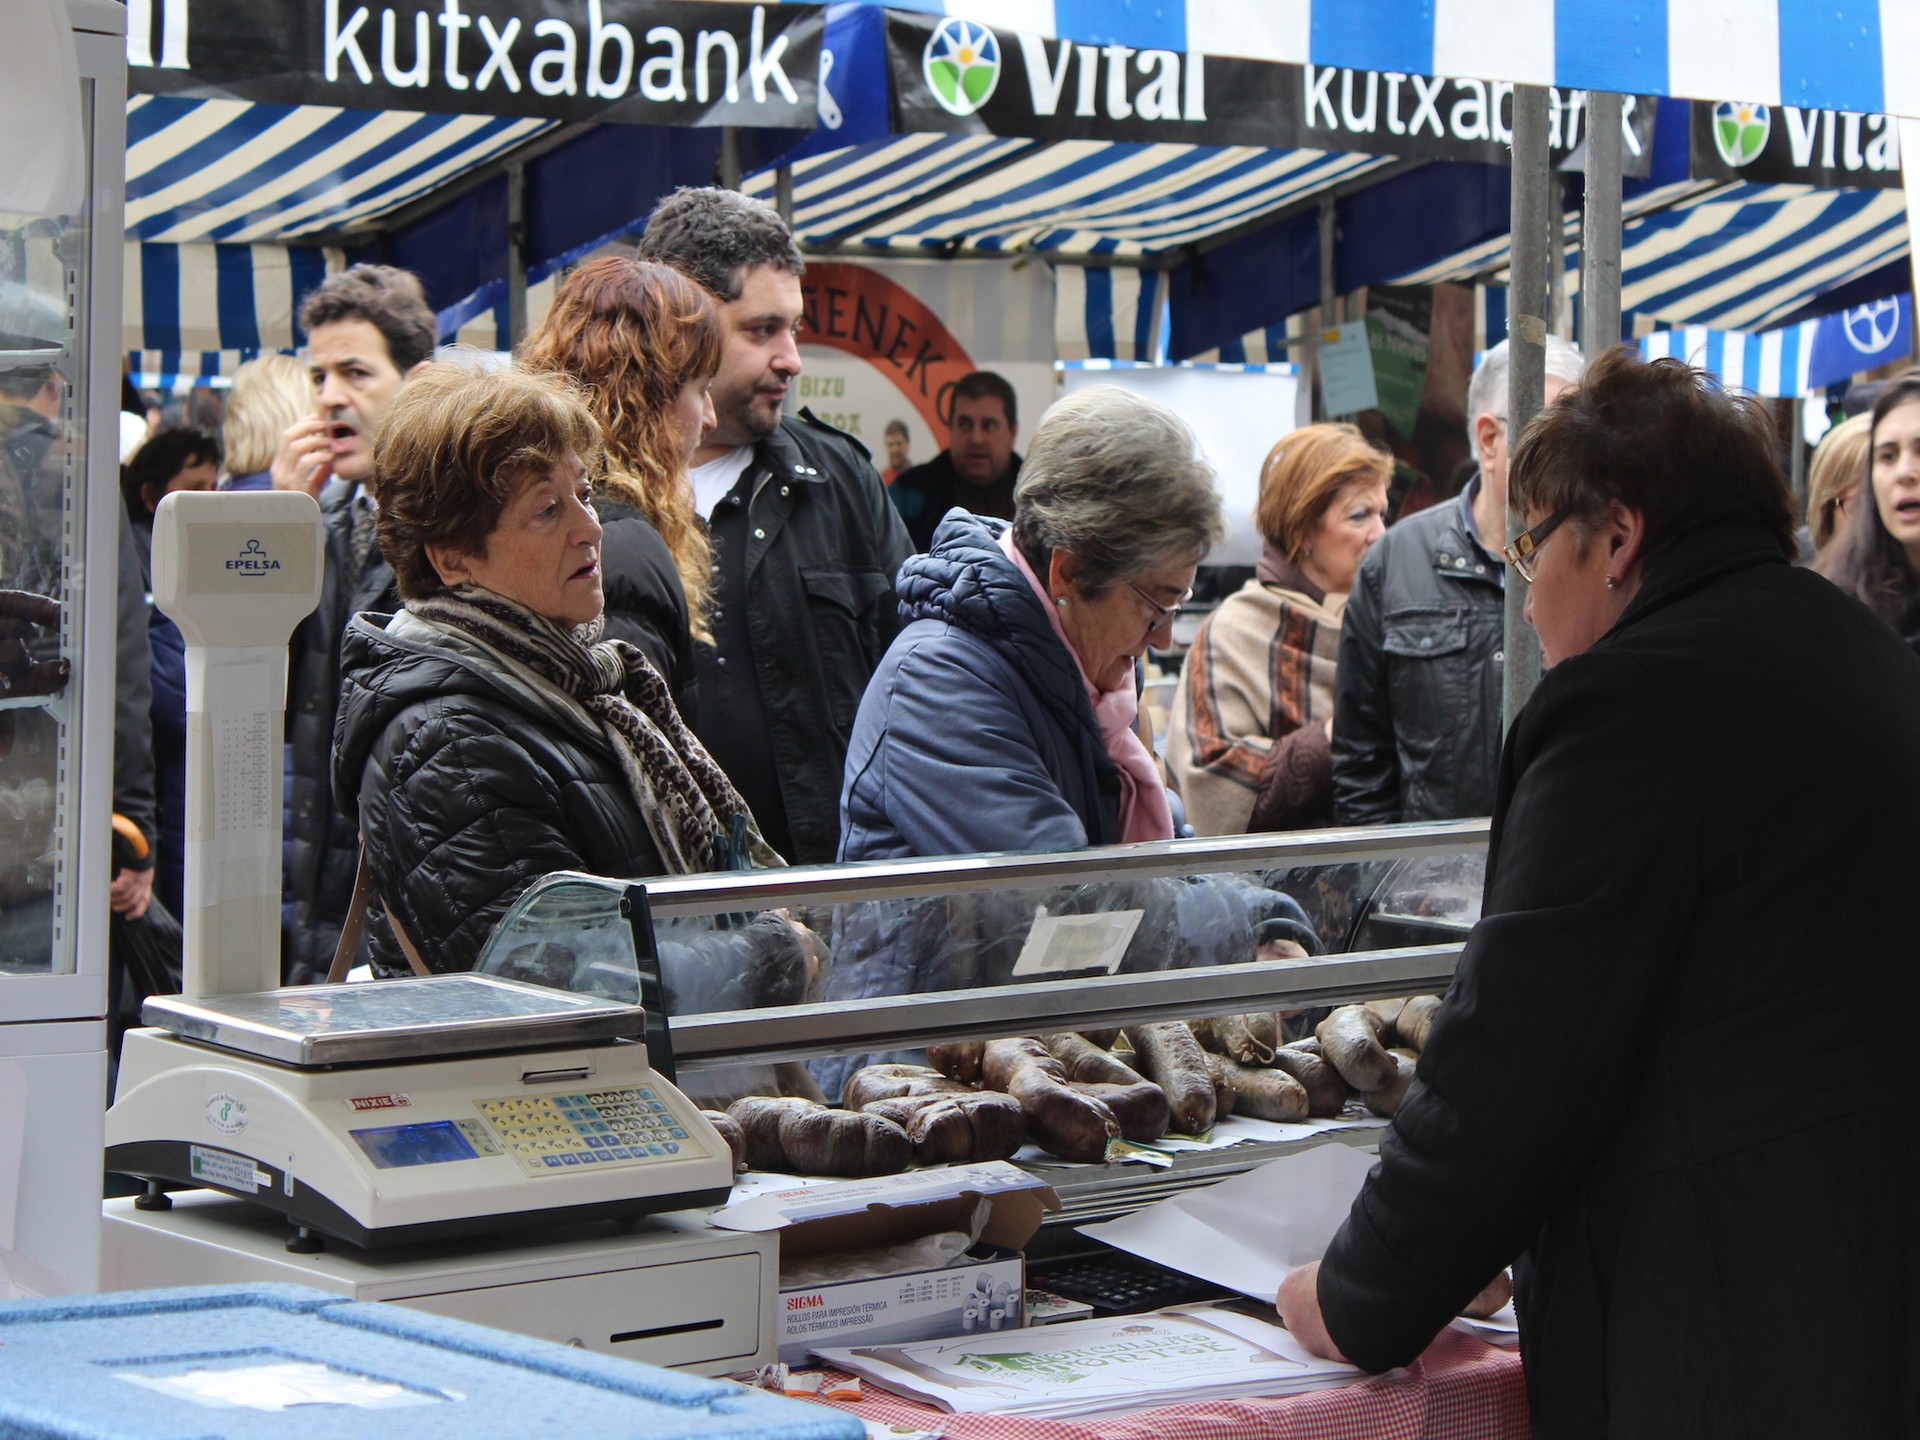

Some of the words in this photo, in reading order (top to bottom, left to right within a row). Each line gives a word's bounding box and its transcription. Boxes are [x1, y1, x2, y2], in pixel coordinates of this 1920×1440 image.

[324, 0, 800, 104] kutxabank
[1016, 32, 1207, 121] Vital
[225, 560, 281, 570] EPELSA
[354, 1097, 393, 1108] NIXIE
[787, 1294, 824, 1310] SIGMA
[787, 1312, 811, 1324] ROLLOS
[812, 1309, 828, 1320] PARA
[829, 1303, 861, 1317] IMPRESIÓN
[862, 1301, 888, 1314] TÉRMICA
[787, 1324, 807, 1335] ROLOS
[808, 1319, 839, 1333] TÉRMICOS
[840, 1314, 874, 1327] IMPRESSÃO
